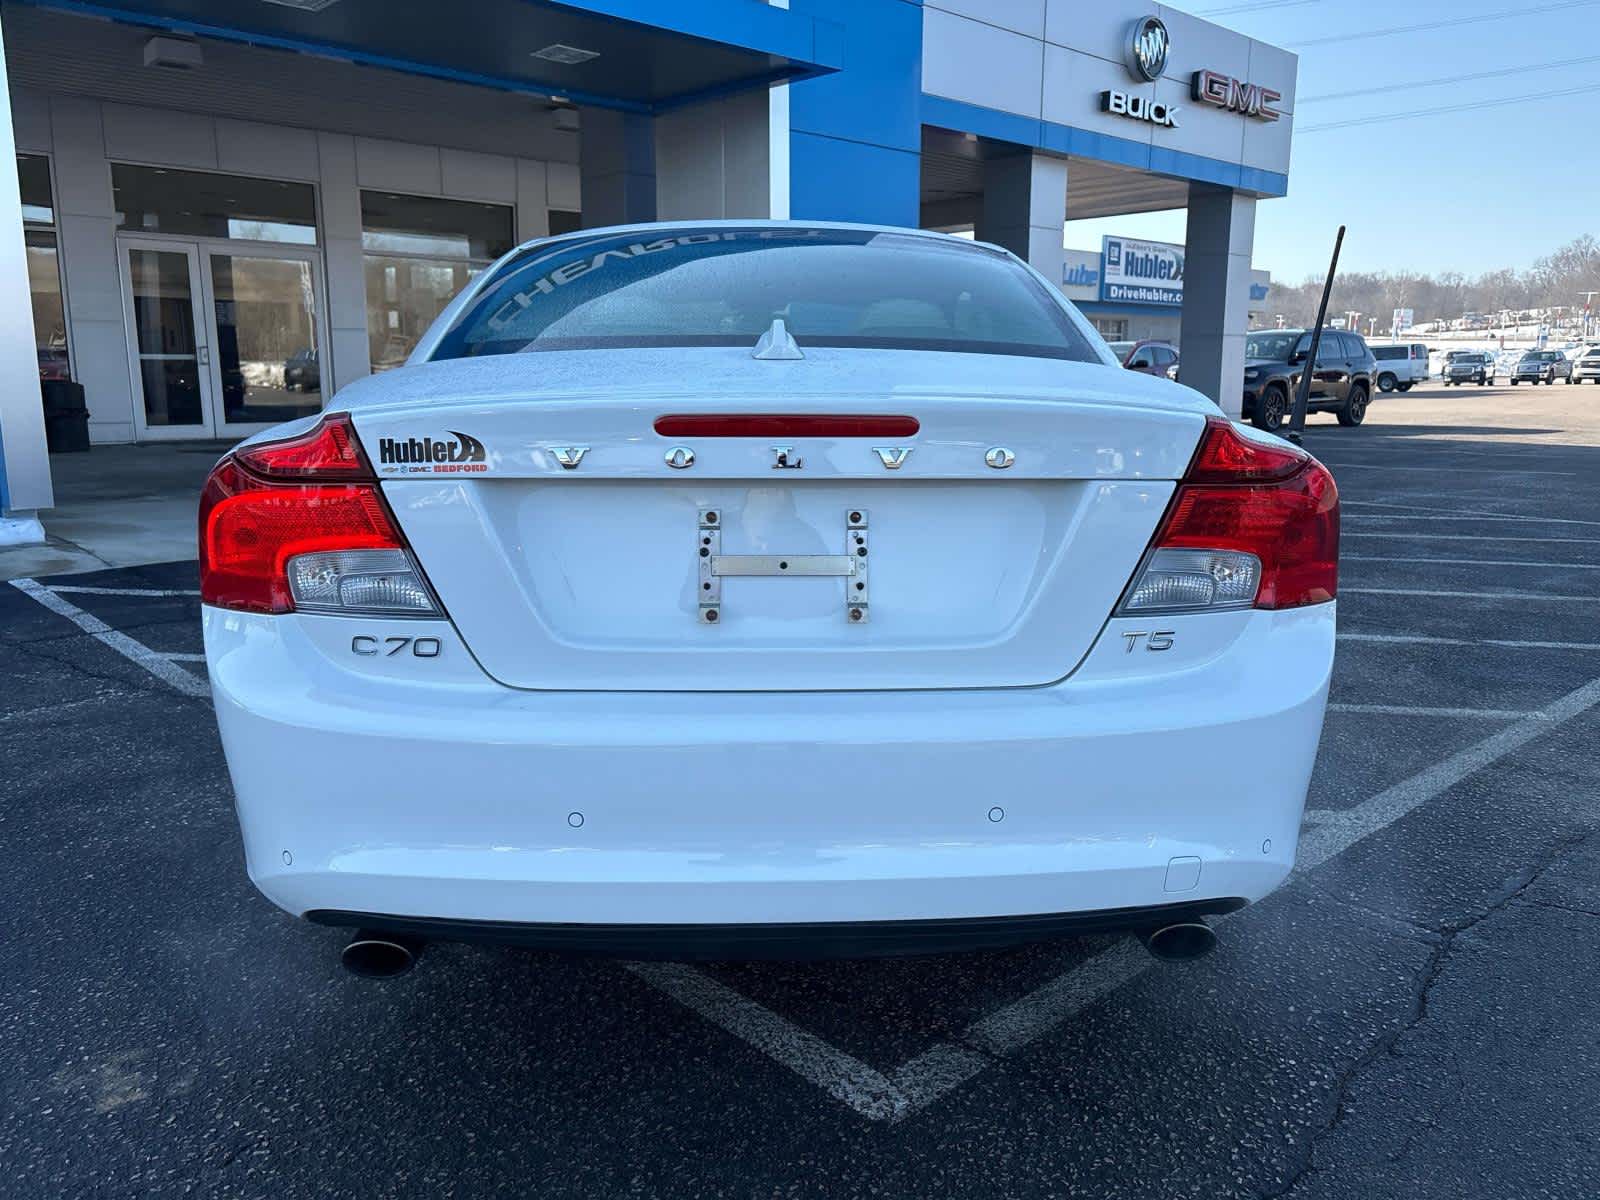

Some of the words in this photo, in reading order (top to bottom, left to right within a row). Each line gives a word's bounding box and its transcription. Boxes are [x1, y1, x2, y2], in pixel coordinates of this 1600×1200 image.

[1200, 69, 1281, 121] GMC
[1109, 89, 1182, 129] BUICK
[1124, 251, 1174, 280] Hubler
[1110, 286, 1184, 303] DriveHubler.c
[379, 438, 458, 463] Hubler
[547, 446, 1016, 470] VOLVO
[433, 464, 488, 473] BEDFORD
[351, 635, 442, 658] C70
[1121, 630, 1176, 654] T5
